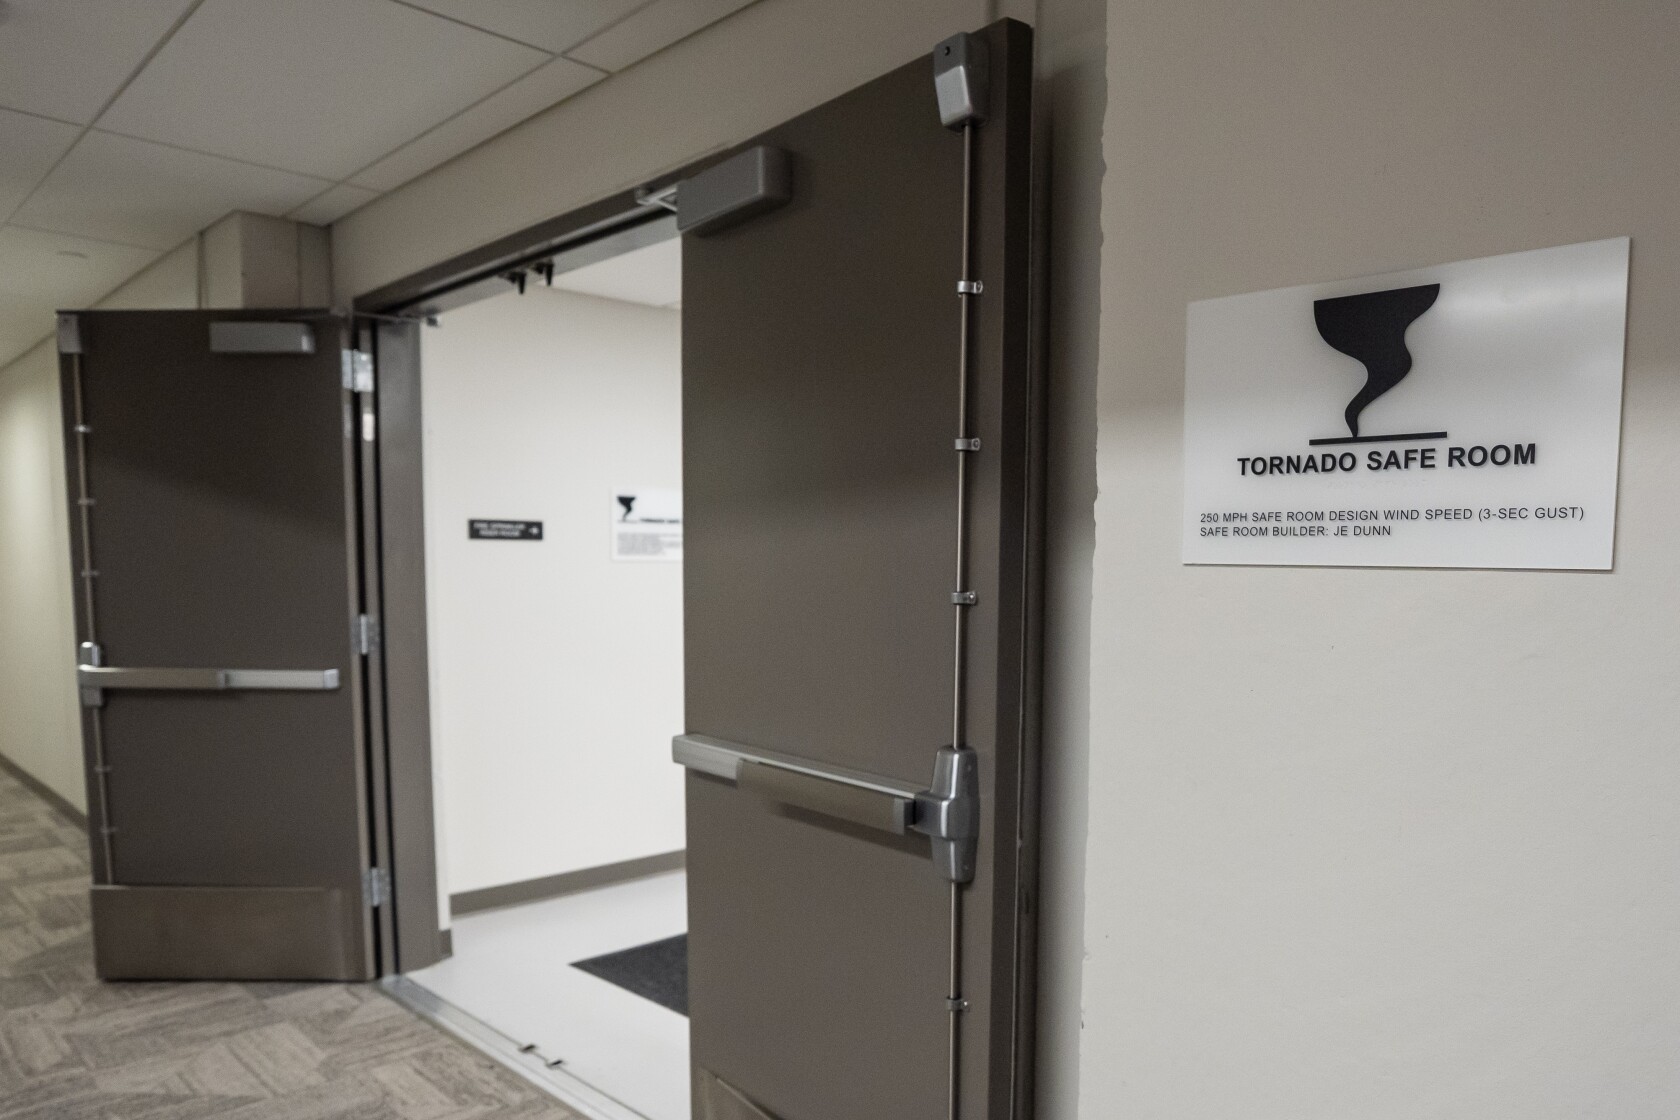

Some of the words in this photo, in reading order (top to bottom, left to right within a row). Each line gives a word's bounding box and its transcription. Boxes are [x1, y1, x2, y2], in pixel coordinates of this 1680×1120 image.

[1237, 453, 1357, 476] TORNADO
[1366, 448, 1436, 471] SAFE
[1447, 443, 1536, 468] ROOM
[1200, 512, 1219, 523] 250
[1222, 512, 1248, 523] MPH
[1251, 511, 1282, 522] SAFE
[1286, 511, 1325, 522] ROOM
[1328, 510, 1379, 521] DESIGN
[1383, 509, 1420, 520] WIND
[1424, 508, 1473, 520] SPEED
[1478, 508, 1529, 522] (3-SEC
[1534, 506, 1585, 521] GUST)
[1199, 526, 1229, 537] SAFE
[1232, 526, 1269, 537] ROOM
[1272, 526, 1329, 537] BUILDER:
[1333, 525, 1349, 537] JE
[1353, 525, 1391, 536] DUNN
